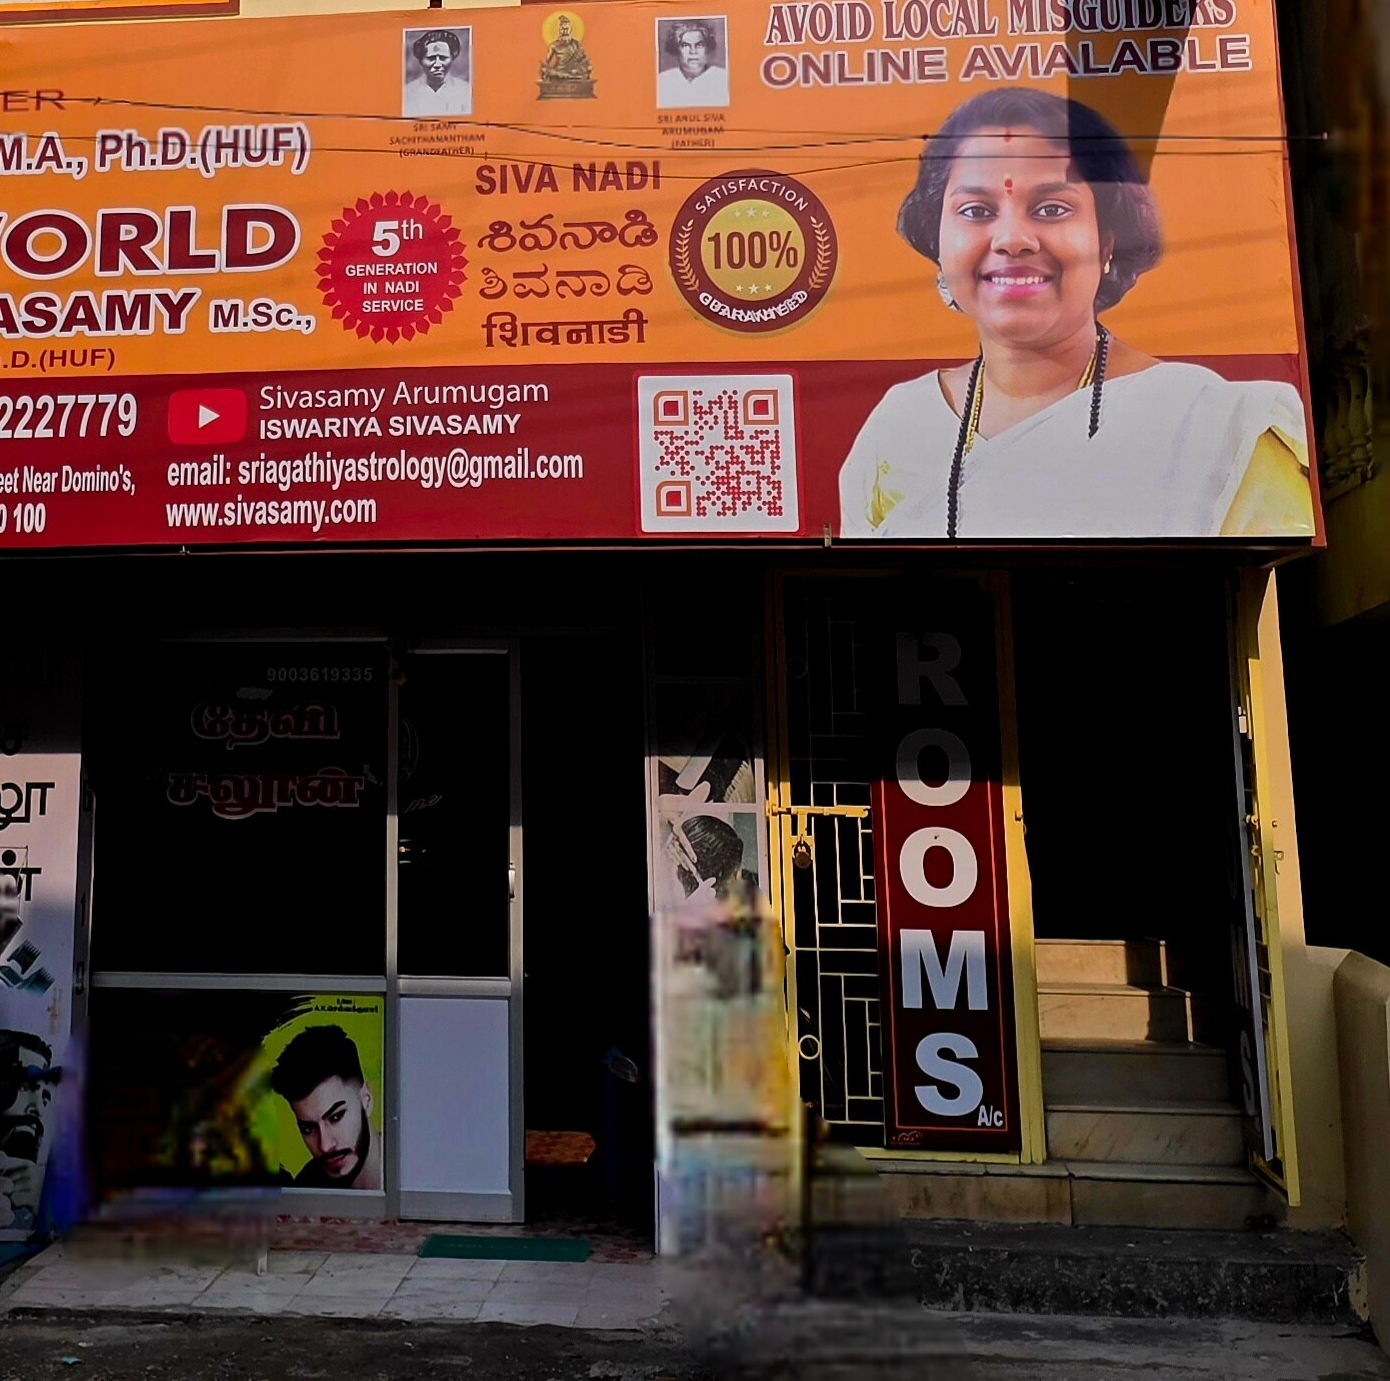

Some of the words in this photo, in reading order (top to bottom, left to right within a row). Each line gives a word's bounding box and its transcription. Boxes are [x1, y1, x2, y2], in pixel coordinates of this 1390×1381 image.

[764, 0, 873, 46] AVOID
[761, 45, 947, 88] ONLINE
[960, 34, 1253, 81] AVIALABLE
[96, 123, 311, 176] Ph.D.(HUF)
[475, 164, 559, 195] SIVA
[573, 160, 660, 192] NADI
[695, 179, 808, 214] SATISFACTION
[370, 219, 425, 257] 5th
[707, 231, 798, 269] 100%
[345, 261, 438, 278] GENERATION
[363, 281, 378, 294] IN
[385, 280, 420, 294] NADI
[209, 299, 316, 335] M.Sc.,
[362, 299, 425, 314] SERVICE
[482, 308, 648, 347] शिवनाडी
[259, 384, 388, 413] Sivasamy
[392, 380, 550, 410] Arumugam
[259, 416, 383, 441] ISWARIYA
[387, 413, 521, 438] SIVASAMY
[22, 465, 58, 492] Near
[61, 463, 136, 495] Domino's,
[166, 454, 232, 488] email:
[236, 447, 584, 491] sriagathiyastrology@gmail.com
[14, 503, 46, 533] 100
[165, 494, 378, 534] www.sivasamy.com
[266, 667, 374, 682] 9003619335
[894, 630, 989, 1116] ROOMS
[977, 1104, 1004, 1127] A/c
